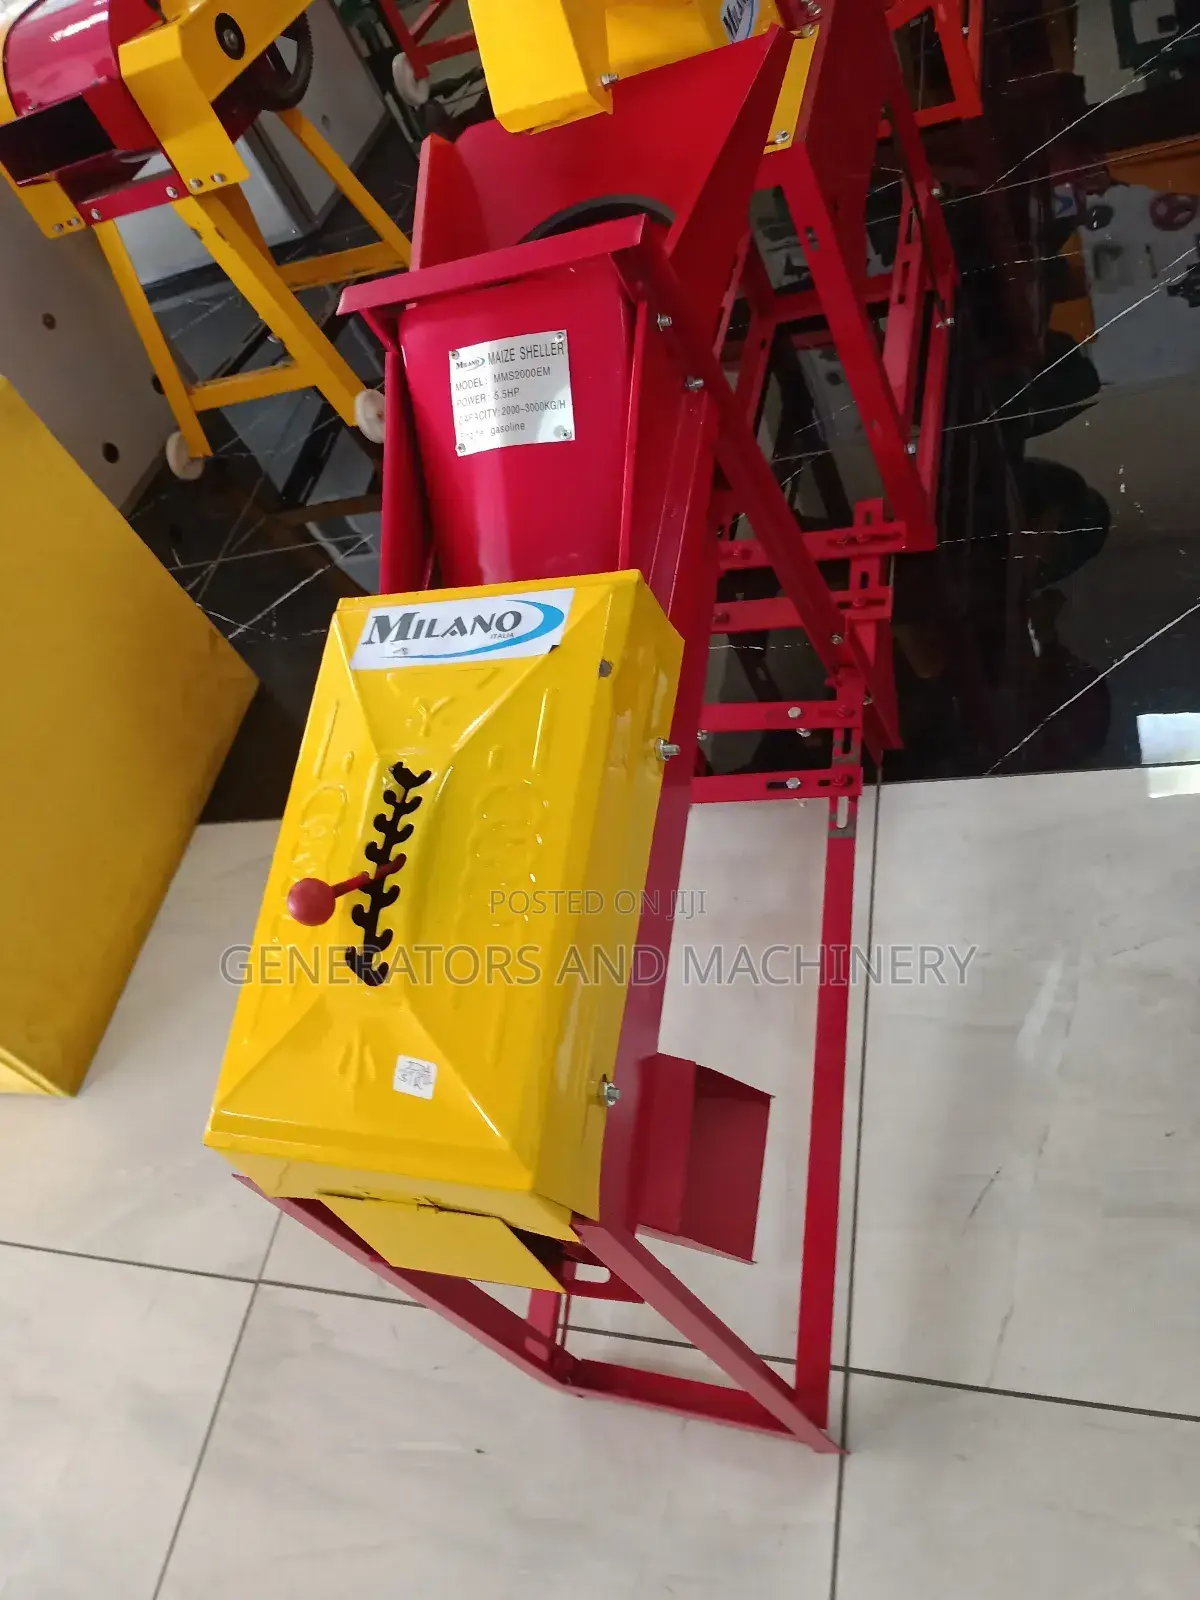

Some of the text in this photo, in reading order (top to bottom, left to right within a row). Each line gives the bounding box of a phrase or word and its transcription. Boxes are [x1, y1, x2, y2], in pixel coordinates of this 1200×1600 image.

[488, 342, 565, 365] MAIZE SHELLER
[493, 366, 551, 383] MMS2000EM
[493, 387, 520, 400] 5.5HP
[490, 421, 526, 437] gasoline
[361, 610, 522, 645] MILANO
[490, 632, 515, 640] ITALIA
